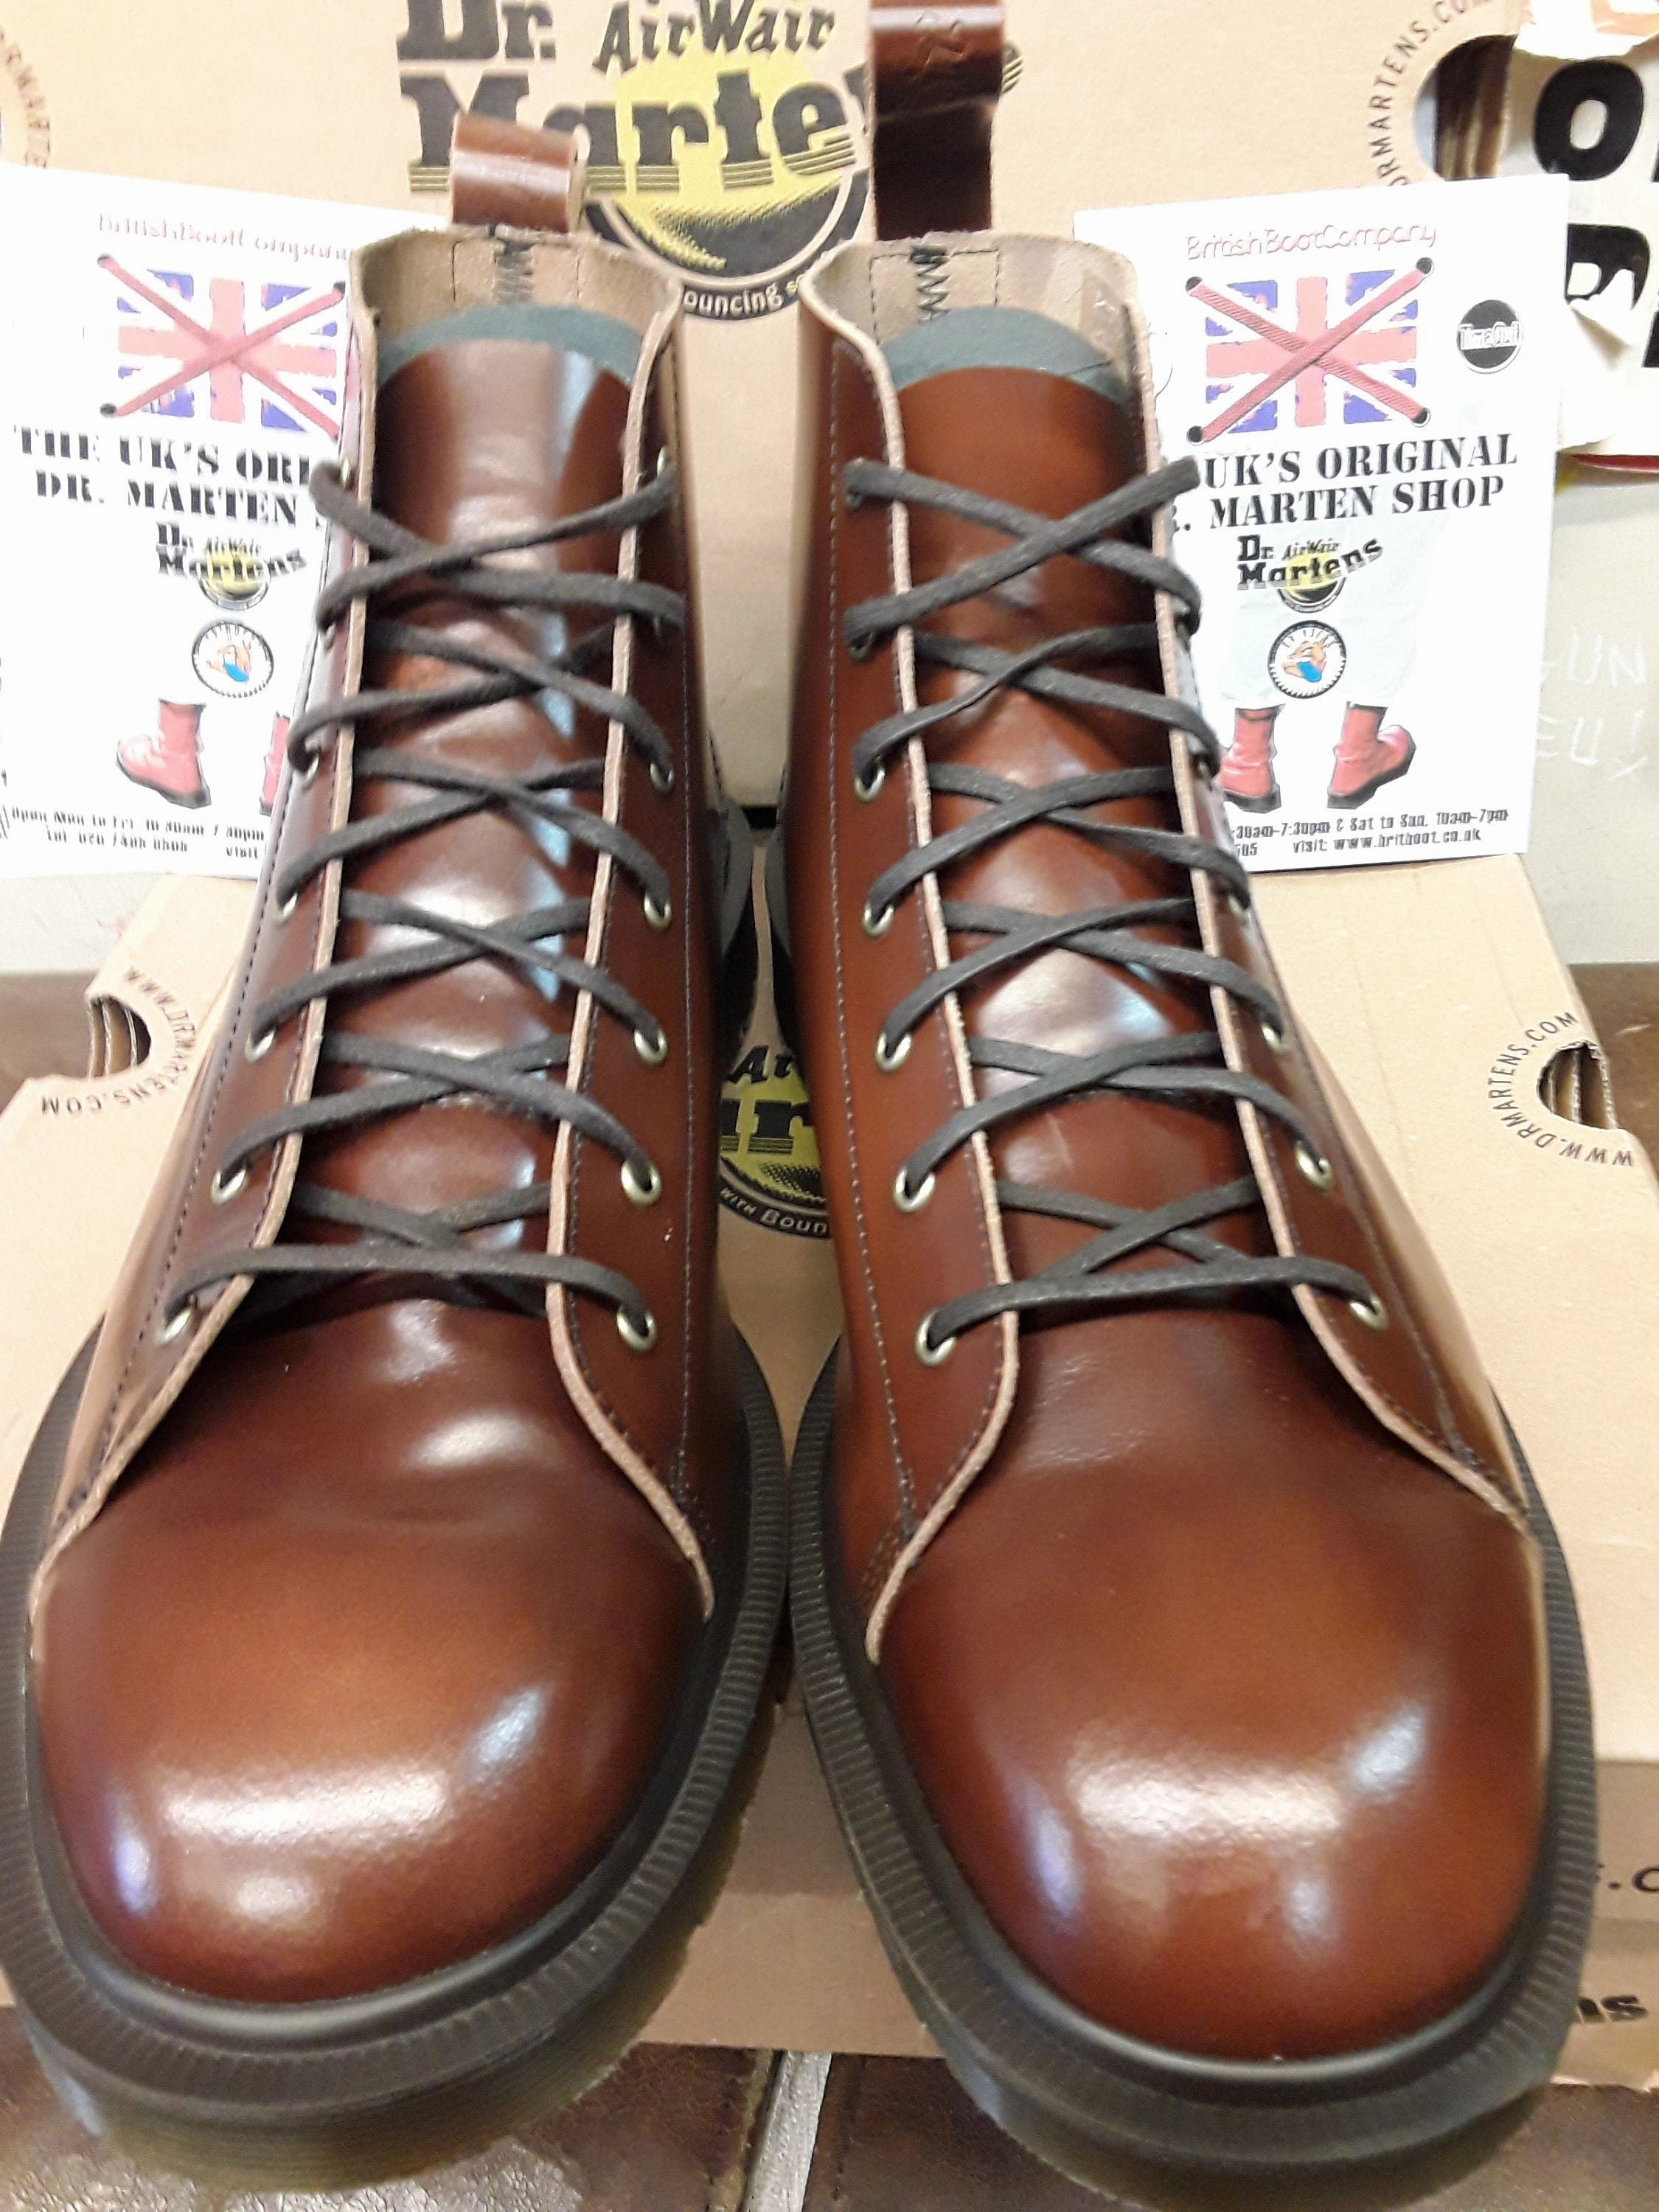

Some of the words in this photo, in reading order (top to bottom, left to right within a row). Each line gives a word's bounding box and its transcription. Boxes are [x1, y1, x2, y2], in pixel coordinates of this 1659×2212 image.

[592, 0, 836, 74] AirWair
[683, 280, 786, 320] ouncing
[236, 448, 312, 486] ORI
[1204, 450, 1300, 489] UK'S
[1315, 434, 1517, 480] ORIGINAL
[127, 479, 299, 526] MARTEN
[1209, 484, 1380, 529] MARTEN
[1392, 476, 1505, 515] SHOP
[1237, 538, 1383, 590] Martens
[1486, 1011, 1635, 1167] WWW.DRMARTENS.COM
[759, 1208, 829, 1235] Boun
